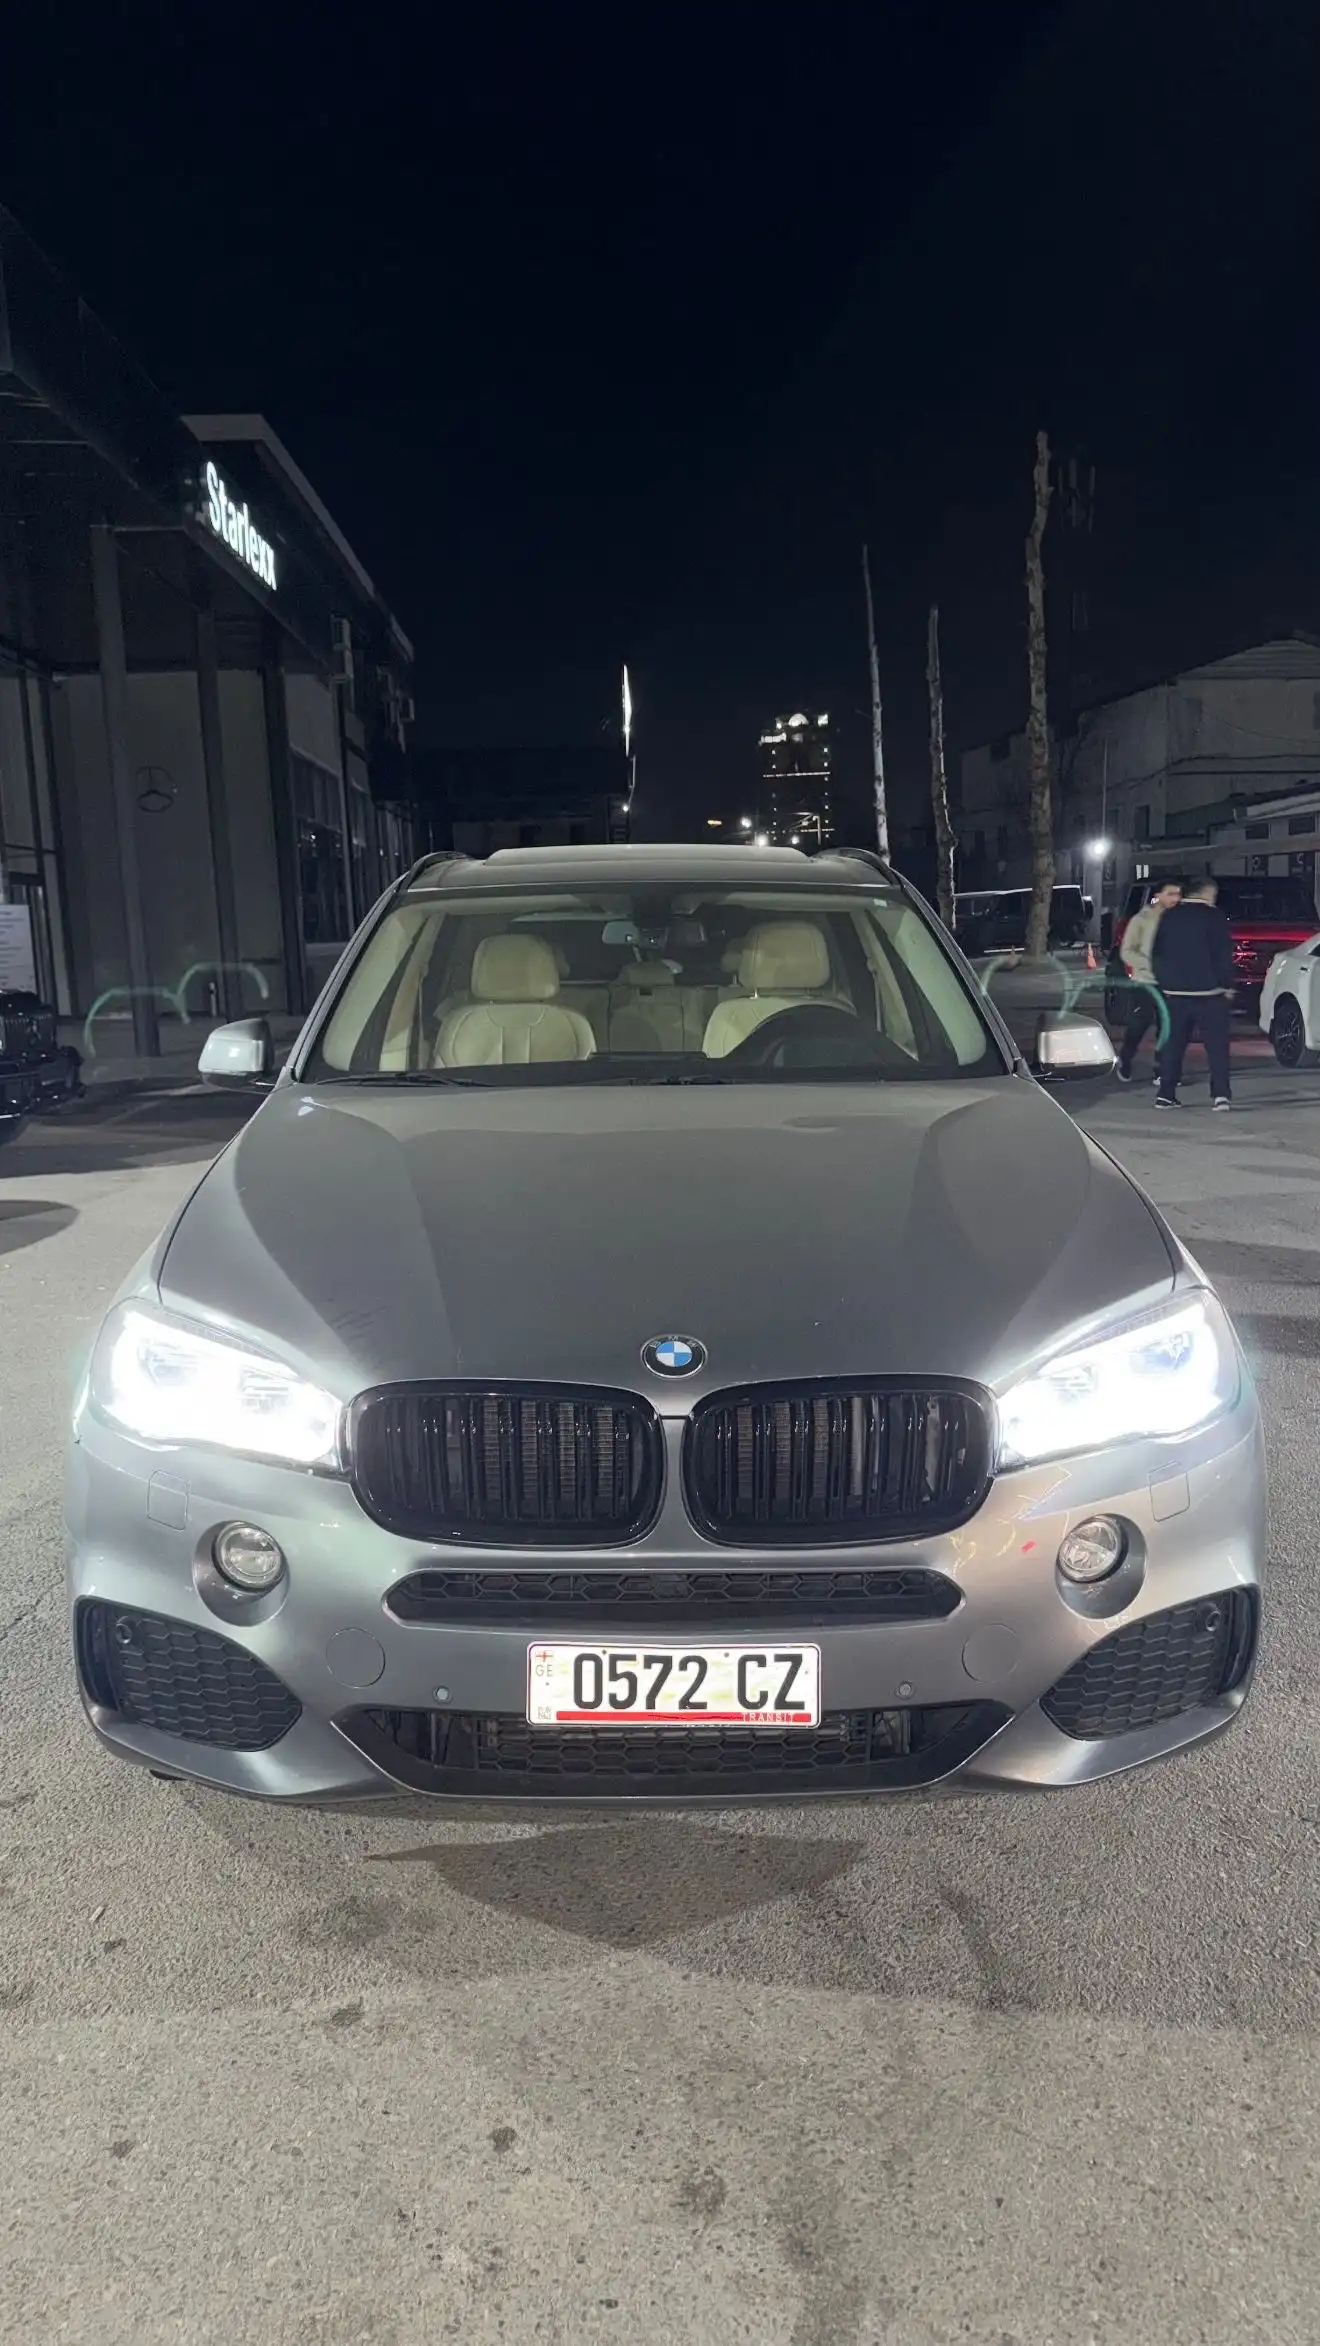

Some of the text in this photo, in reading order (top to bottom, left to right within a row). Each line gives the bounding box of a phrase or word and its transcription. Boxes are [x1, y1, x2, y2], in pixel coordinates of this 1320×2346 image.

[535, 1664, 553, 1677] GE
[573, 1653, 805, 1710] 0572 CZ
[741, 1712, 795, 1723] TRANSIT
